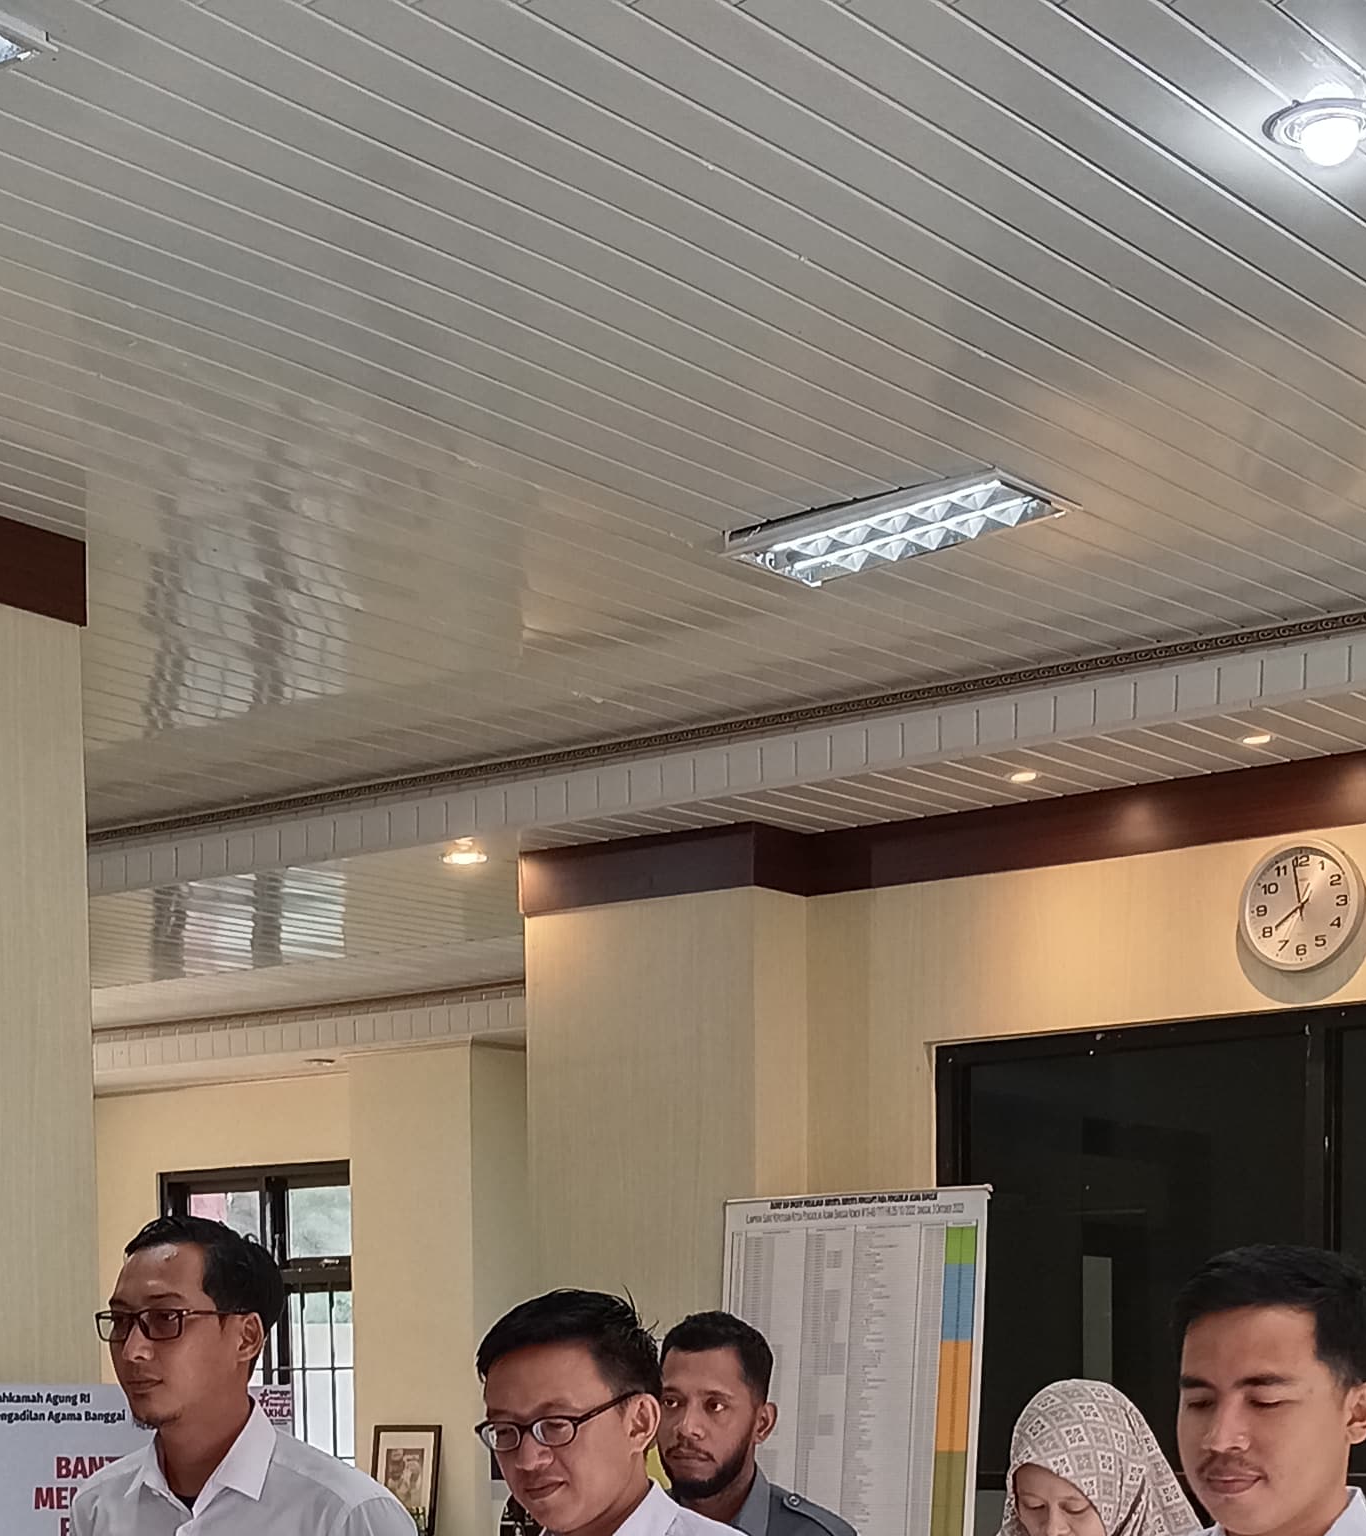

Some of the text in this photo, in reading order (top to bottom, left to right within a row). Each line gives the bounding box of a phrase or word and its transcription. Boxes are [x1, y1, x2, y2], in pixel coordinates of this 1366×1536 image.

[1292, 854, 1310, 868] 12
[1318, 860, 1325, 871] 1
[1275, 865, 1287, 876] 11
[1329, 873, 1342, 886] 2
[1261, 882, 1279, 895] 10
[1335, 894, 1348, 906] 3
[1255, 905, 1267, 917] 9
[1329, 916, 1341, 928] 4
[1262, 926, 1273, 938] 8
[1278, 939, 1289, 951] 7
[1314, 935, 1327, 947] 5
[1295, 943, 1307, 956] 6
[46, 1392, 77, 1406] Agung
[79, 1393, 91, 1404] RI
[47, 1410, 82, 1424] Agama
[84, 1409, 126, 1424] Banggai
